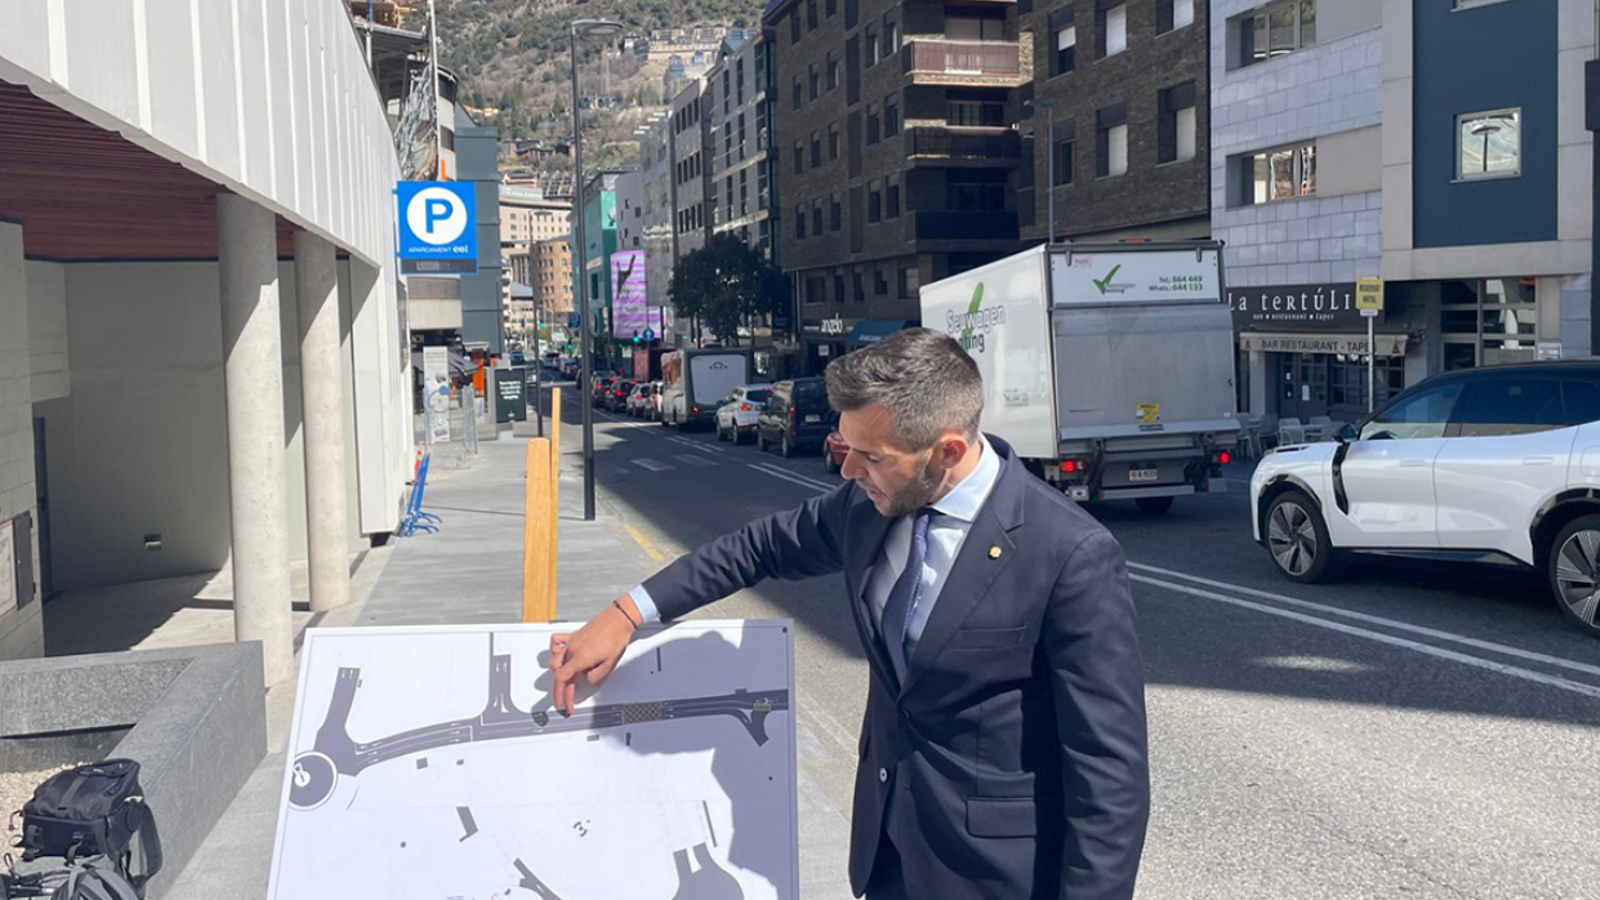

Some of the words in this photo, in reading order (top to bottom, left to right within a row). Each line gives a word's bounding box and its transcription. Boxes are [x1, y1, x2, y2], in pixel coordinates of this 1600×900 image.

[425, 198, 454, 234] P
[1261, 339, 1279, 350] BAR
[1280, 339, 1338, 351] RESTAURANT
